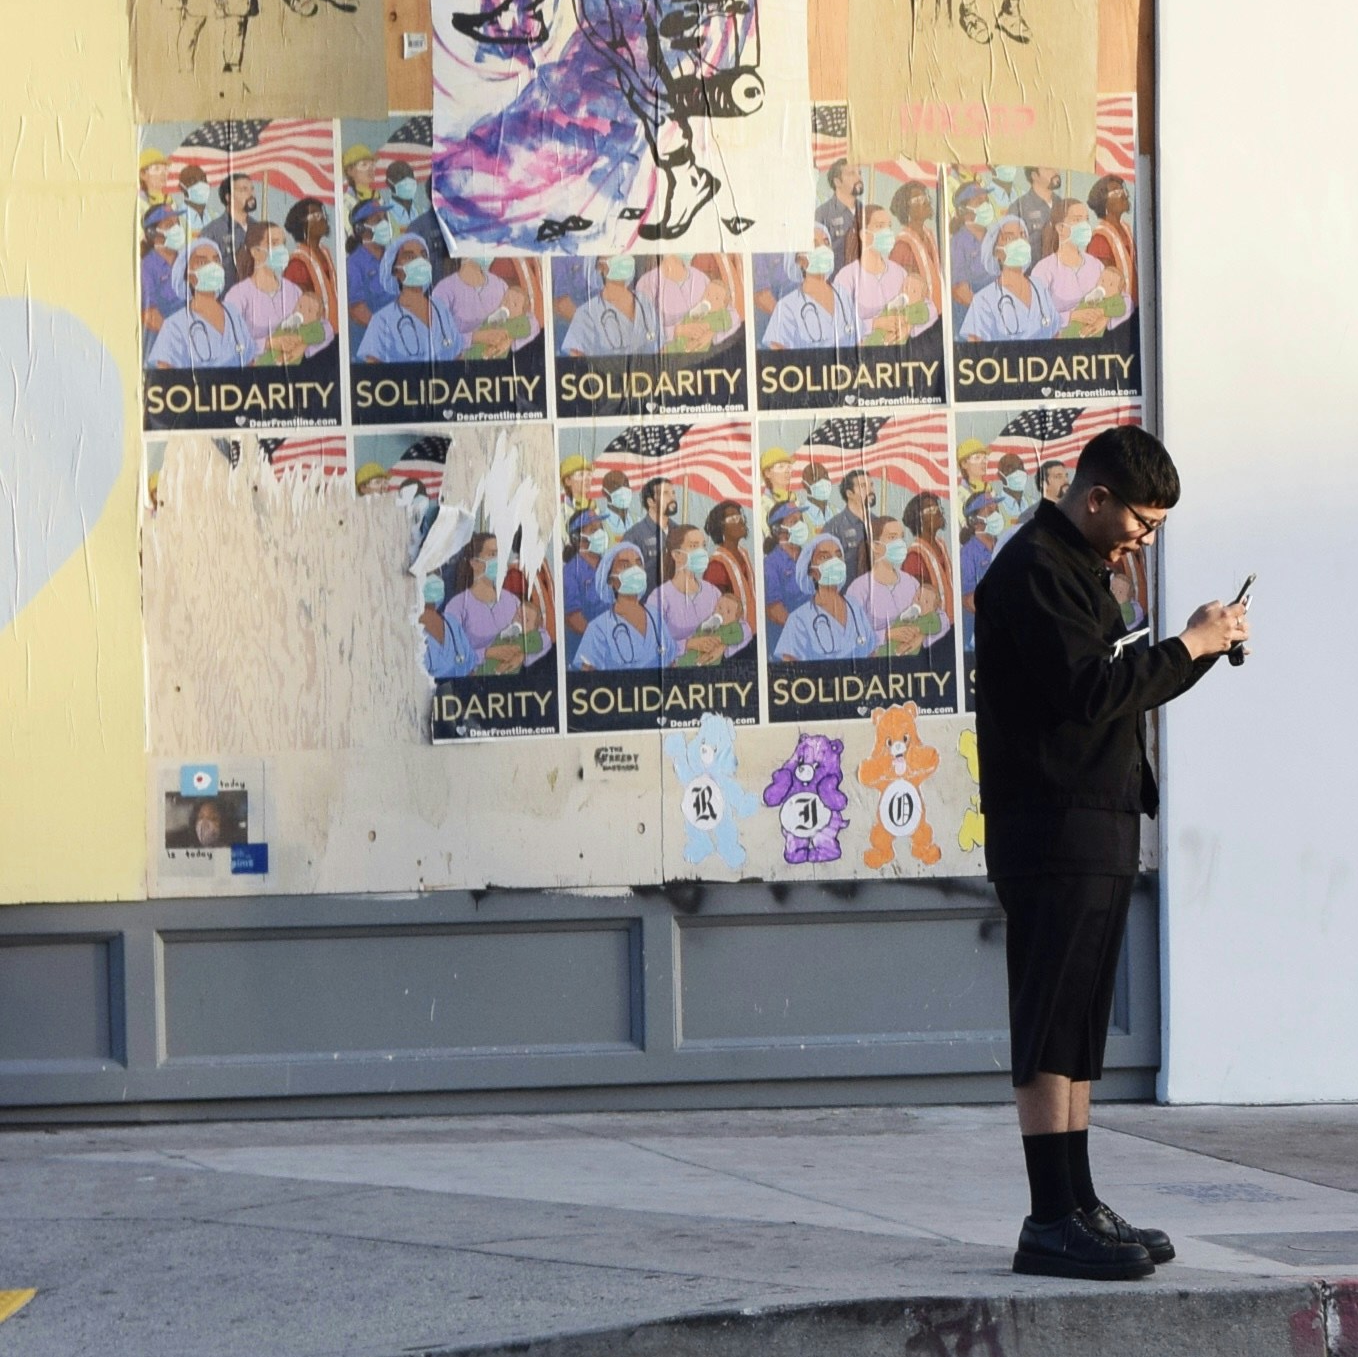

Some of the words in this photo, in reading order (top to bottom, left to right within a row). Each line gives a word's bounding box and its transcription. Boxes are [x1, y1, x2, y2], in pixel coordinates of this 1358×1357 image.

[761, 361, 938, 393] SOLIDARITY
[958, 354, 1134, 386] SOLIDARITY
[356, 375, 540, 408] SOLIDARITY
[561, 368, 741, 401] SOLIDARITY
[1054, 387, 1137, 398] DearFrontline.com
[147, 382, 334, 414] SOLIDARITY
[659, 403, 744, 414] DearFrontline.com
[858, 396, 942, 407] DearFrontline.com
[249, 417, 337, 428] DearFrontline.com
[456, 410, 543, 422] DearFrontline.com
[572, 682, 752, 715] SOLIDARITY
[773, 671, 950, 705] SOLIDARITY
[434, 691, 552, 721] IDARITY
[470, 726, 555, 737] DearFrontline.com
[219, 778, 245, 789] today
[184, 850, 213, 860] today
